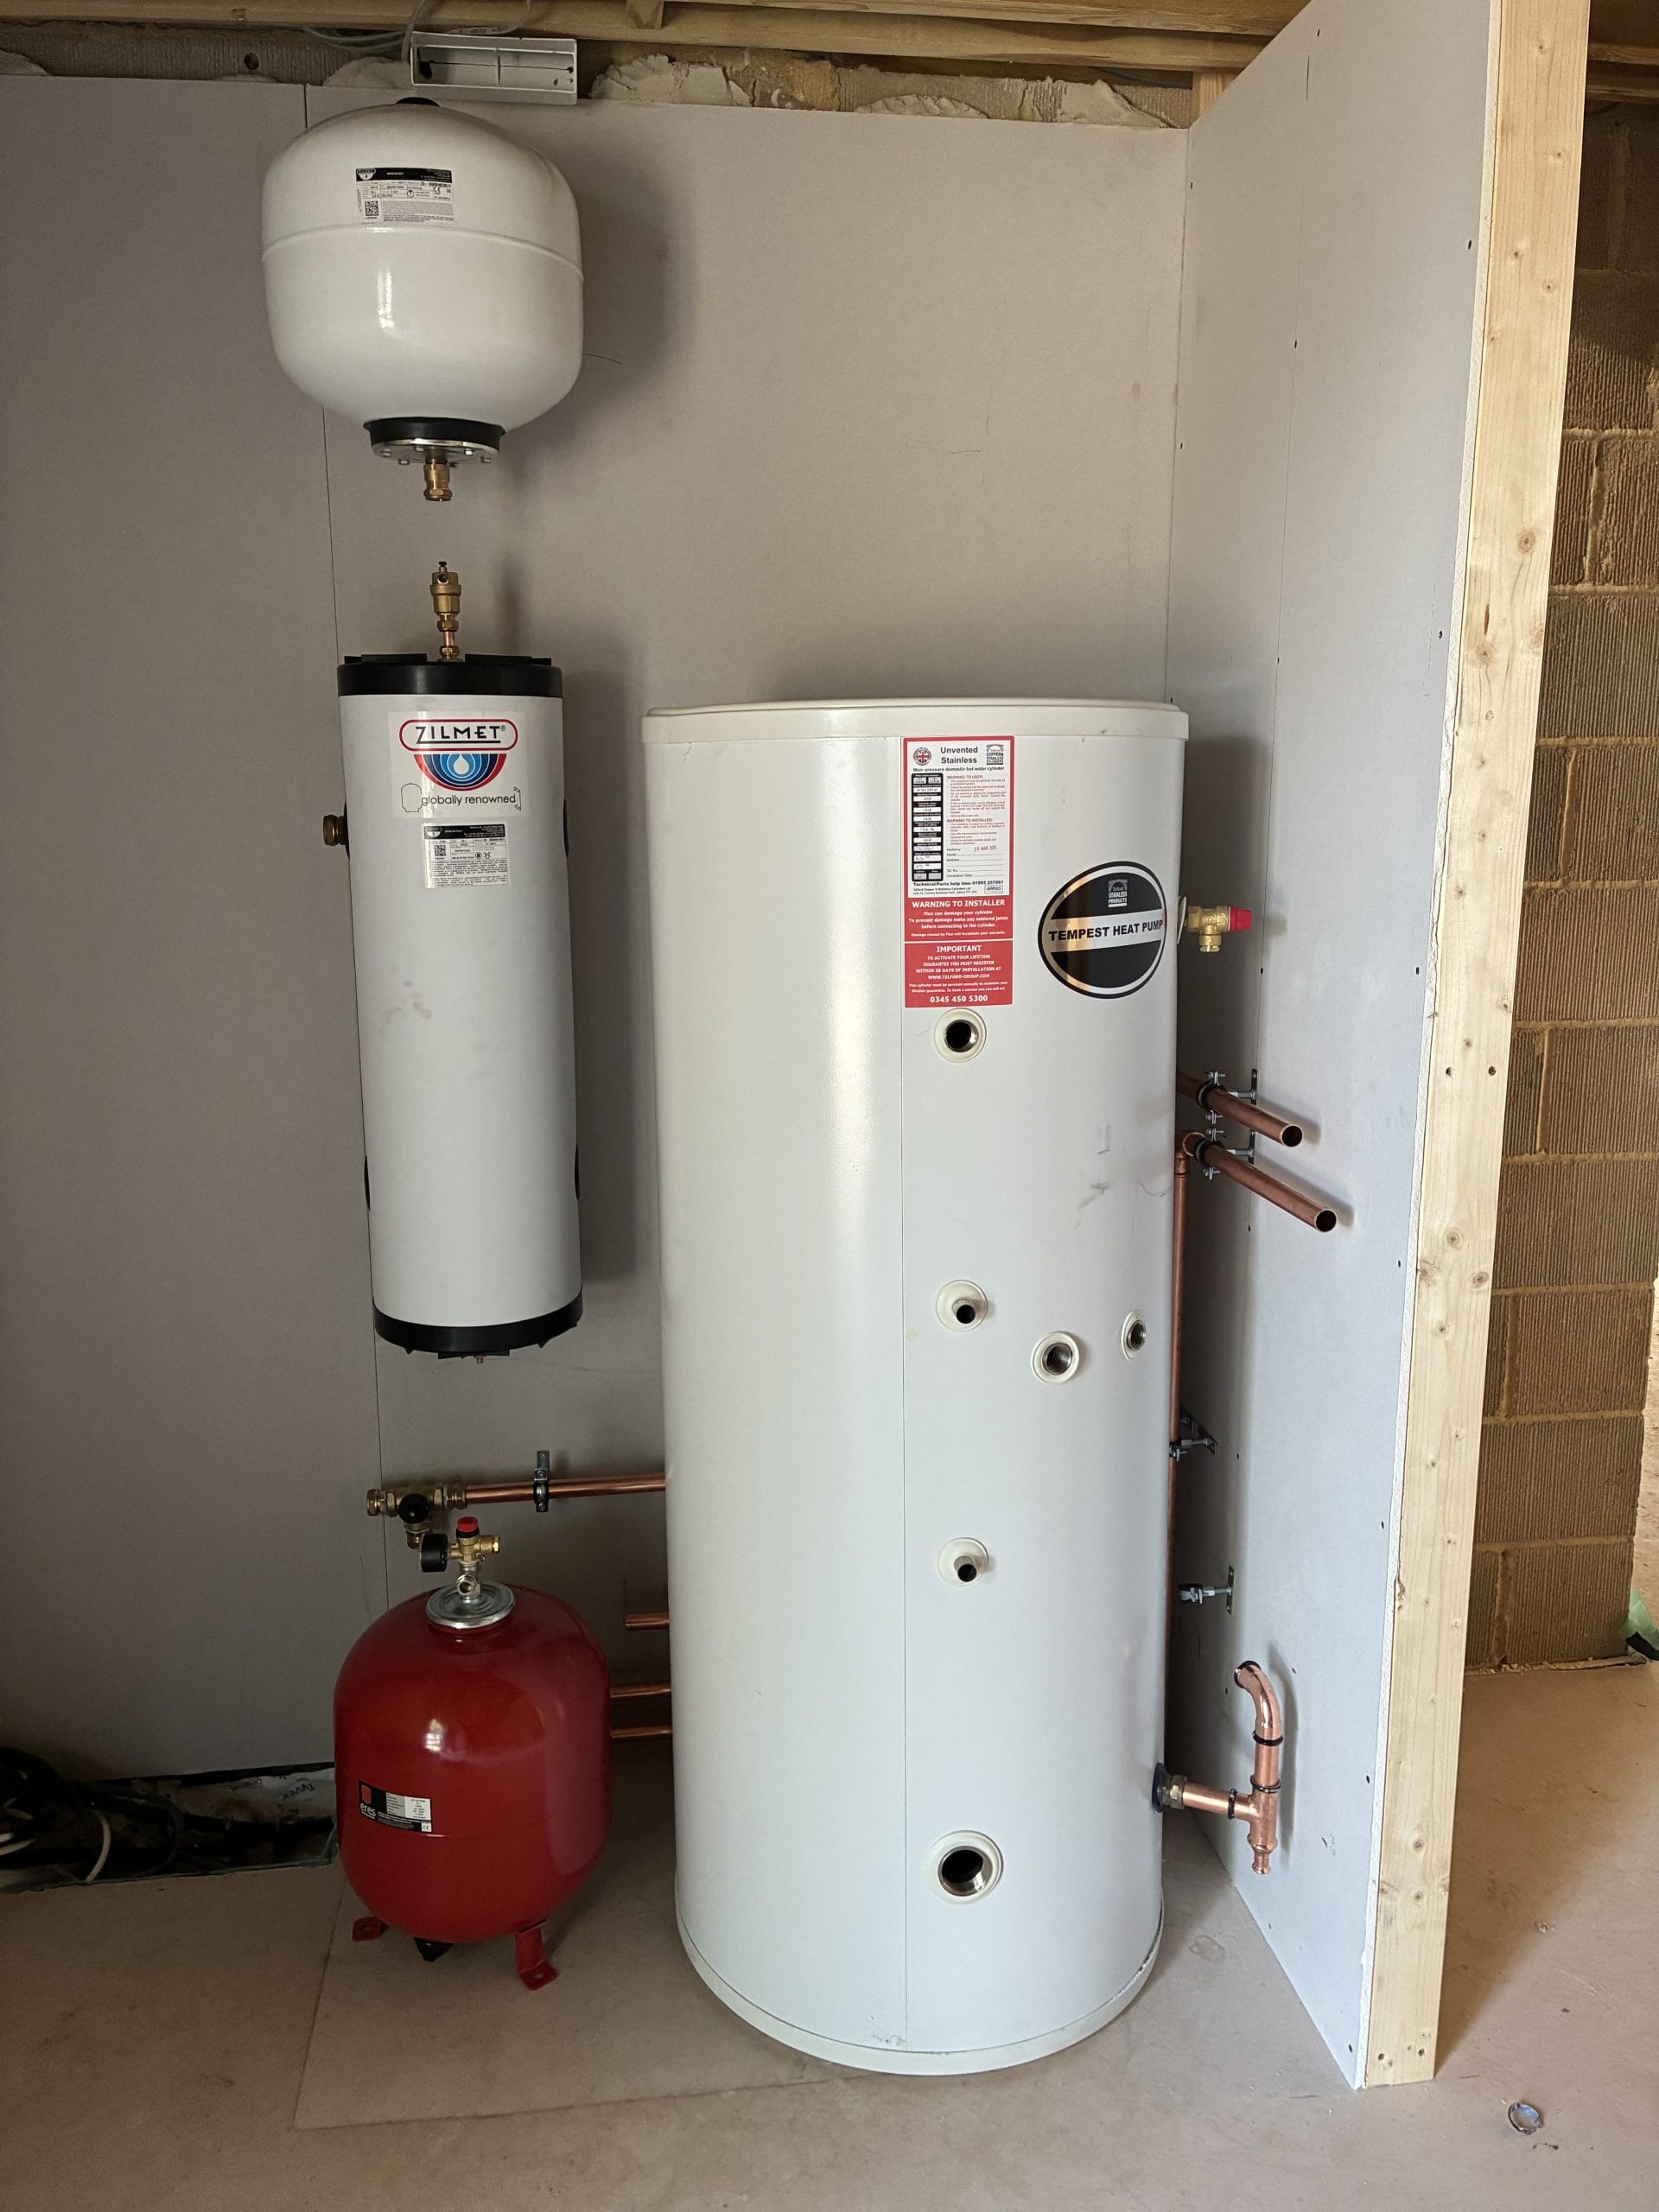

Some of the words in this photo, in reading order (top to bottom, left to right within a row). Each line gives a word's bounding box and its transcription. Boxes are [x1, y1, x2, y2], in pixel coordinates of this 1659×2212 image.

[416, 726, 500, 744] ZILMET
[421, 795, 462, 806] globally
[465, 794, 516, 804] renowned
[1048, 927, 1109, 941] TEMPEST
[1113, 923, 1140, 936] HEAT
[1142, 919, 1163, 932] PUMP
[360, 1803, 376, 1817] eres
